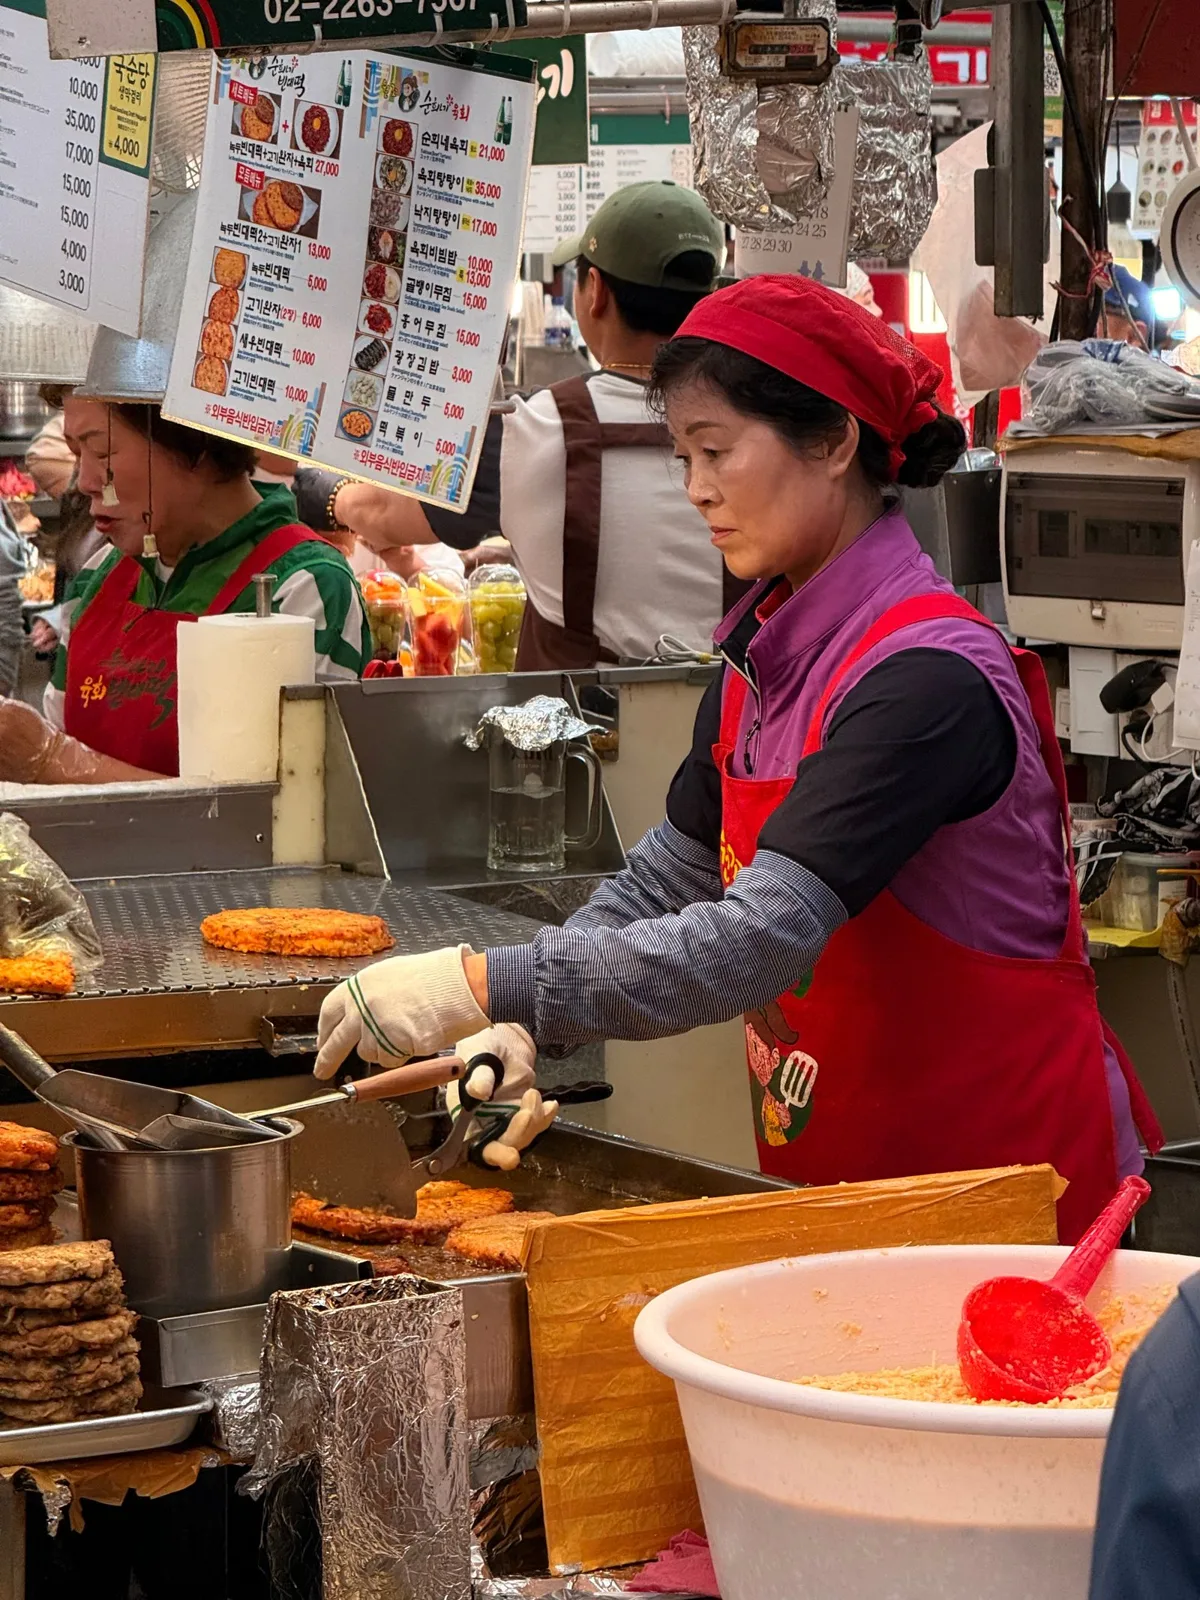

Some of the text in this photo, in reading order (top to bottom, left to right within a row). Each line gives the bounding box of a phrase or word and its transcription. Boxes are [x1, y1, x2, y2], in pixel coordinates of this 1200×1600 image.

[113, 55, 150, 90] 국순당
[69, 77, 98, 101] 10,000
[119, 86, 141, 106] 생막걸리
[231, 83, 255, 105] 세트메뉴
[277, 73, 306, 98] 빈대떡
[64, 108, 96, 134] 35,000
[452, 103, 471, 122] 육회
[65, 141, 94, 166] 17,000
[114, 135, 139, 158] 4,000
[421, 131, 469, 156] 순희네육회
[479, 144, 506, 162] 21,000
[315, 159, 339, 177] 27,000
[62, 172, 91, 198] 15,000
[417, 167, 465, 193] 육회탕탕이
[474, 181, 502, 200] 35,000
[60, 205, 89, 230] 15,000
[414, 204, 461, 230] 낙지탕탕이
[471, 218, 498, 237] 17,000
[796, 222, 809, 237] 24
[812, 224, 827, 238] 25
[60, 238, 87, 262] 4,000
[308, 242, 331, 260] 13,000
[410, 241, 457, 267] 육회비빔밥
[467, 255, 493, 273] 10,000
[750, 237, 761, 250] 28
[762, 239, 776, 252] 29
[778, 240, 792, 254] 30
[59, 269, 84, 294] 3,000
[251, 262, 291, 284] 녹두빈대떡
[307, 274, 328, 292] 5,000
[466, 270, 491, 288] 13,000
[405, 277, 453, 303] 골뱅이무침
[462, 292, 487, 311] 15,000
[302, 311, 322, 329] 6,000
[239, 333, 283, 359] 새우빈대떡
[292, 347, 316, 366] 10,000
[456, 328, 481, 347] 15,000
[232, 370, 276, 396] 고기빈대떡
[285, 384, 309, 403] 10,000
[451, 366, 473, 384] 3,000
[443, 402, 465, 420] 5,000
[435, 438, 456, 457] 5,000
